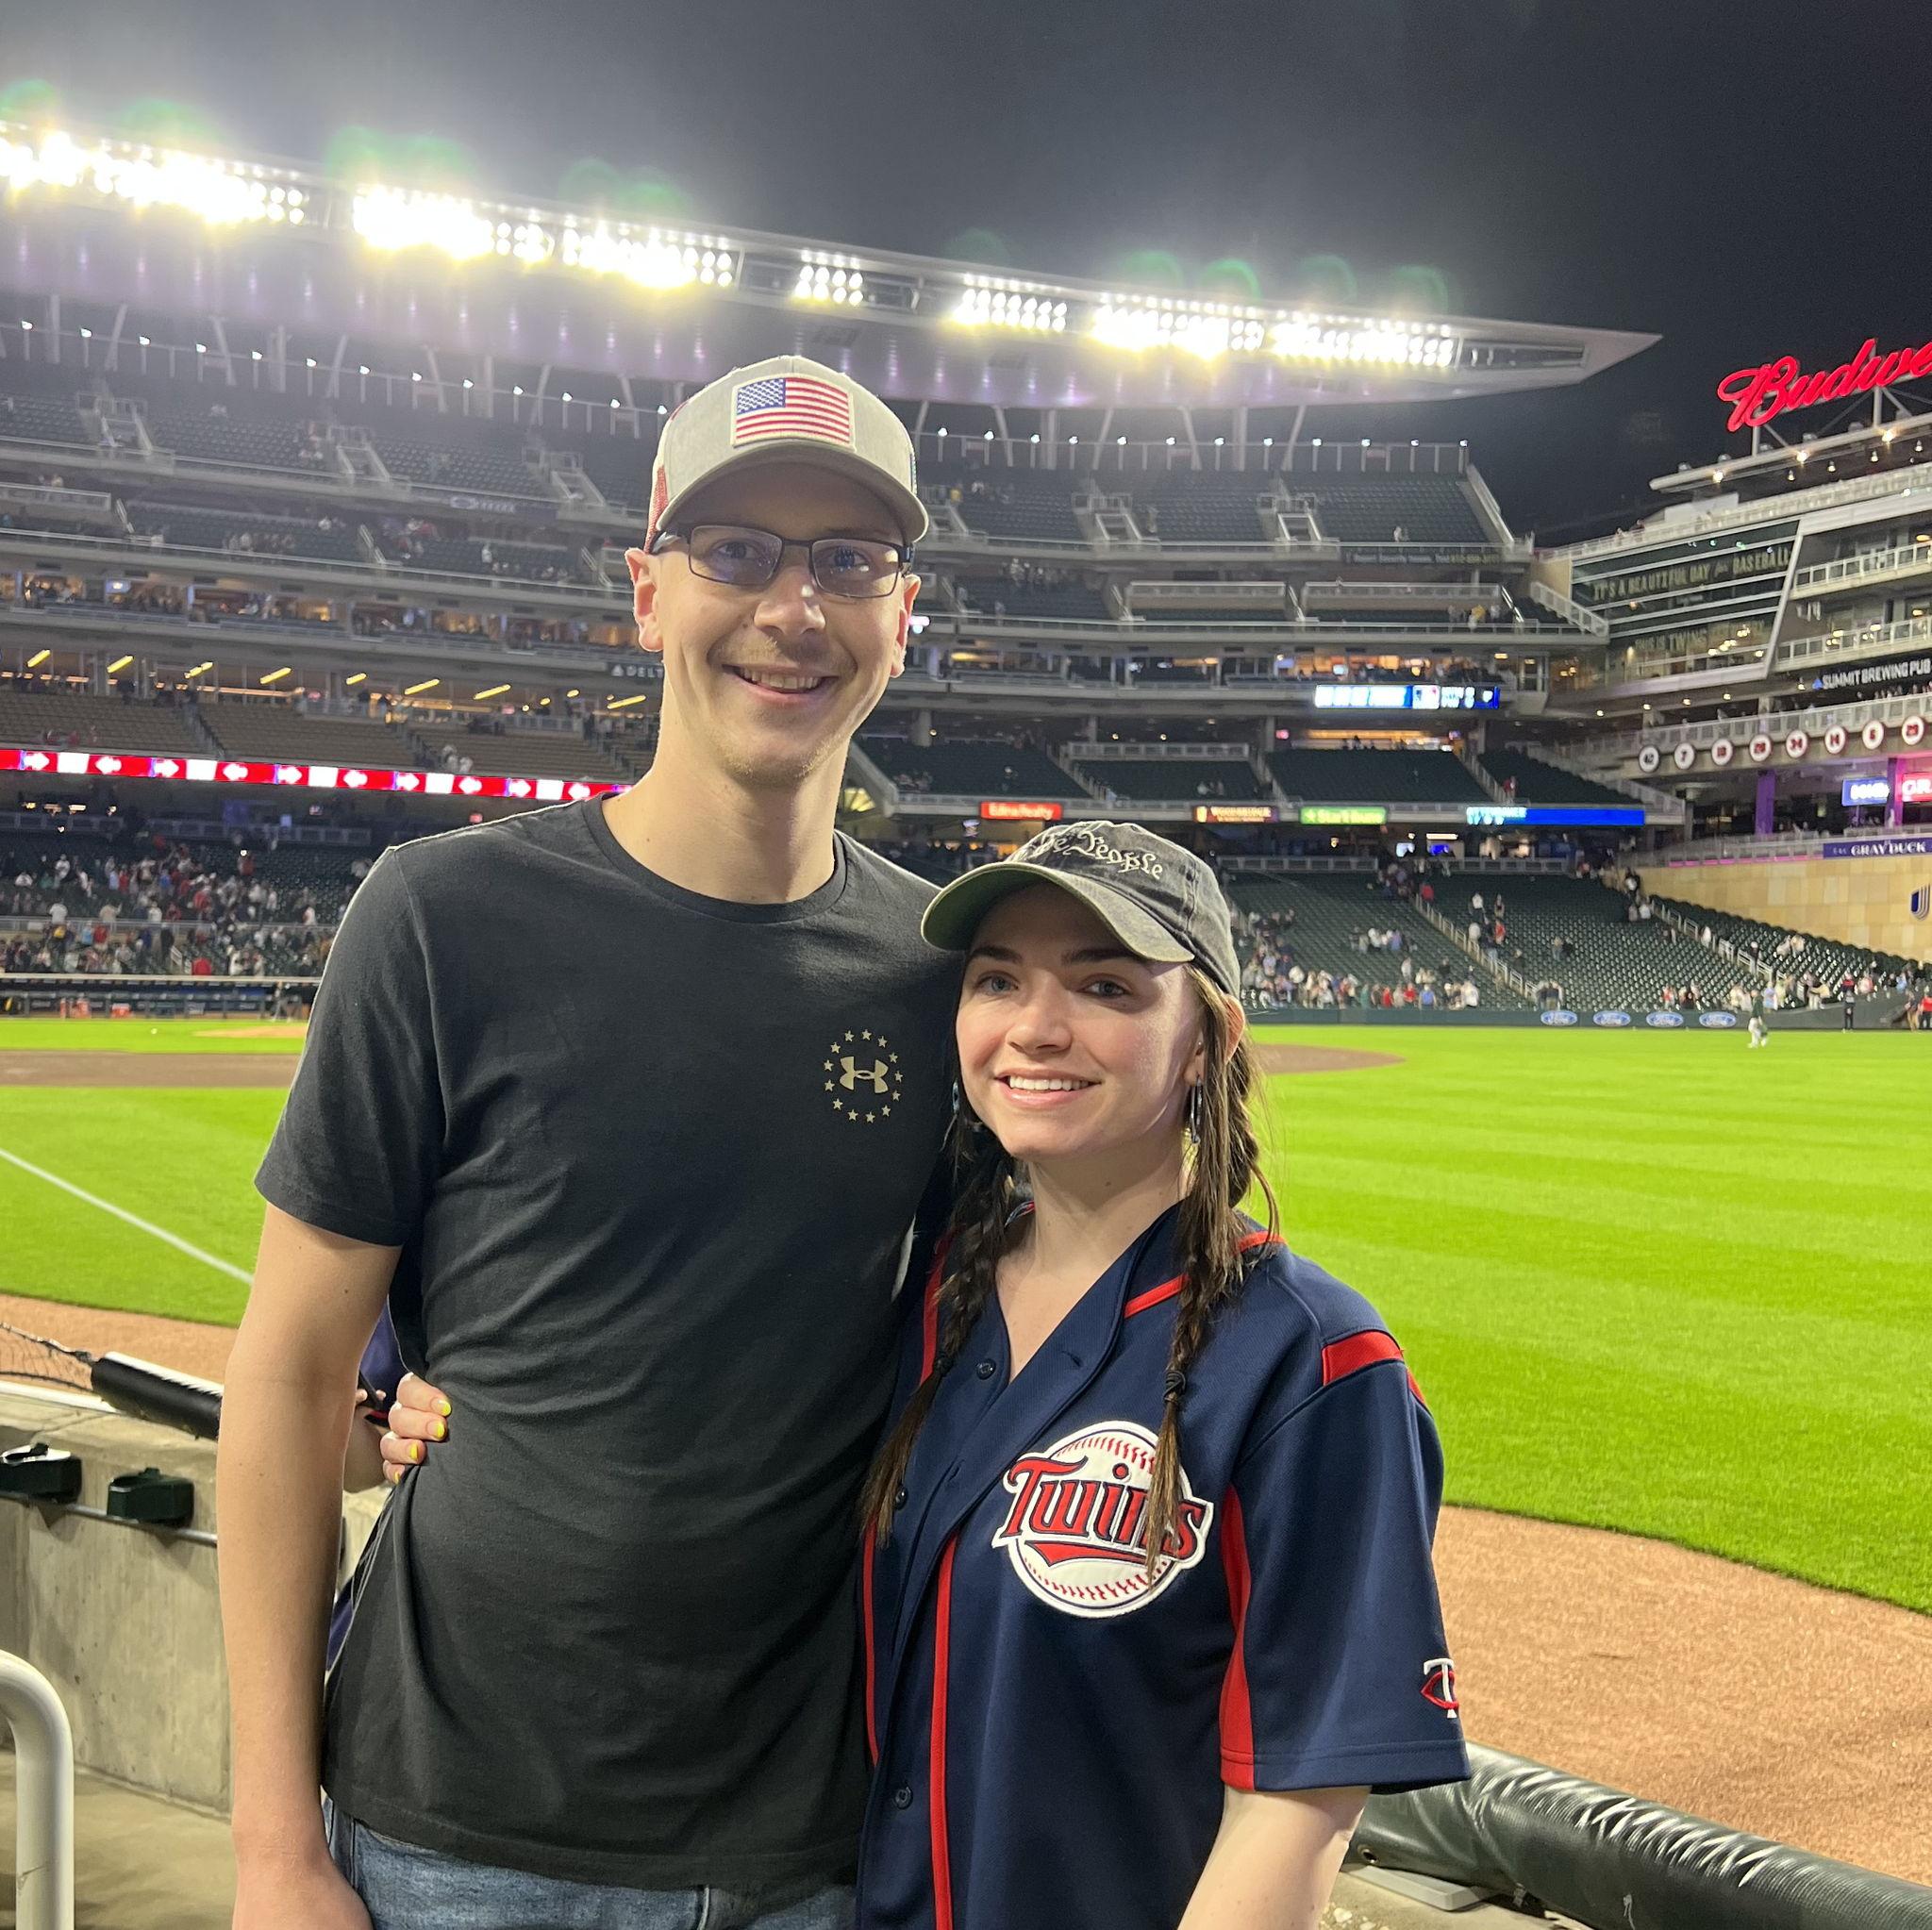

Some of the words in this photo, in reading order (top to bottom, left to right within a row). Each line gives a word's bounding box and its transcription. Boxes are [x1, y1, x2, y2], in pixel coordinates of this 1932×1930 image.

[626, 664, 664, 678] DELT
[1822, 669, 1861, 690] SUMMIT
[1861, 661, 1908, 684] BREWING
[1909, 657, 1931, 676] PUB
[1062, 830, 1163, 880] People
[1850, 843, 1886, 857] GRAY
[1889, 841, 1925, 855] DUCK
[999, 1455, 1208, 1561] Twins
